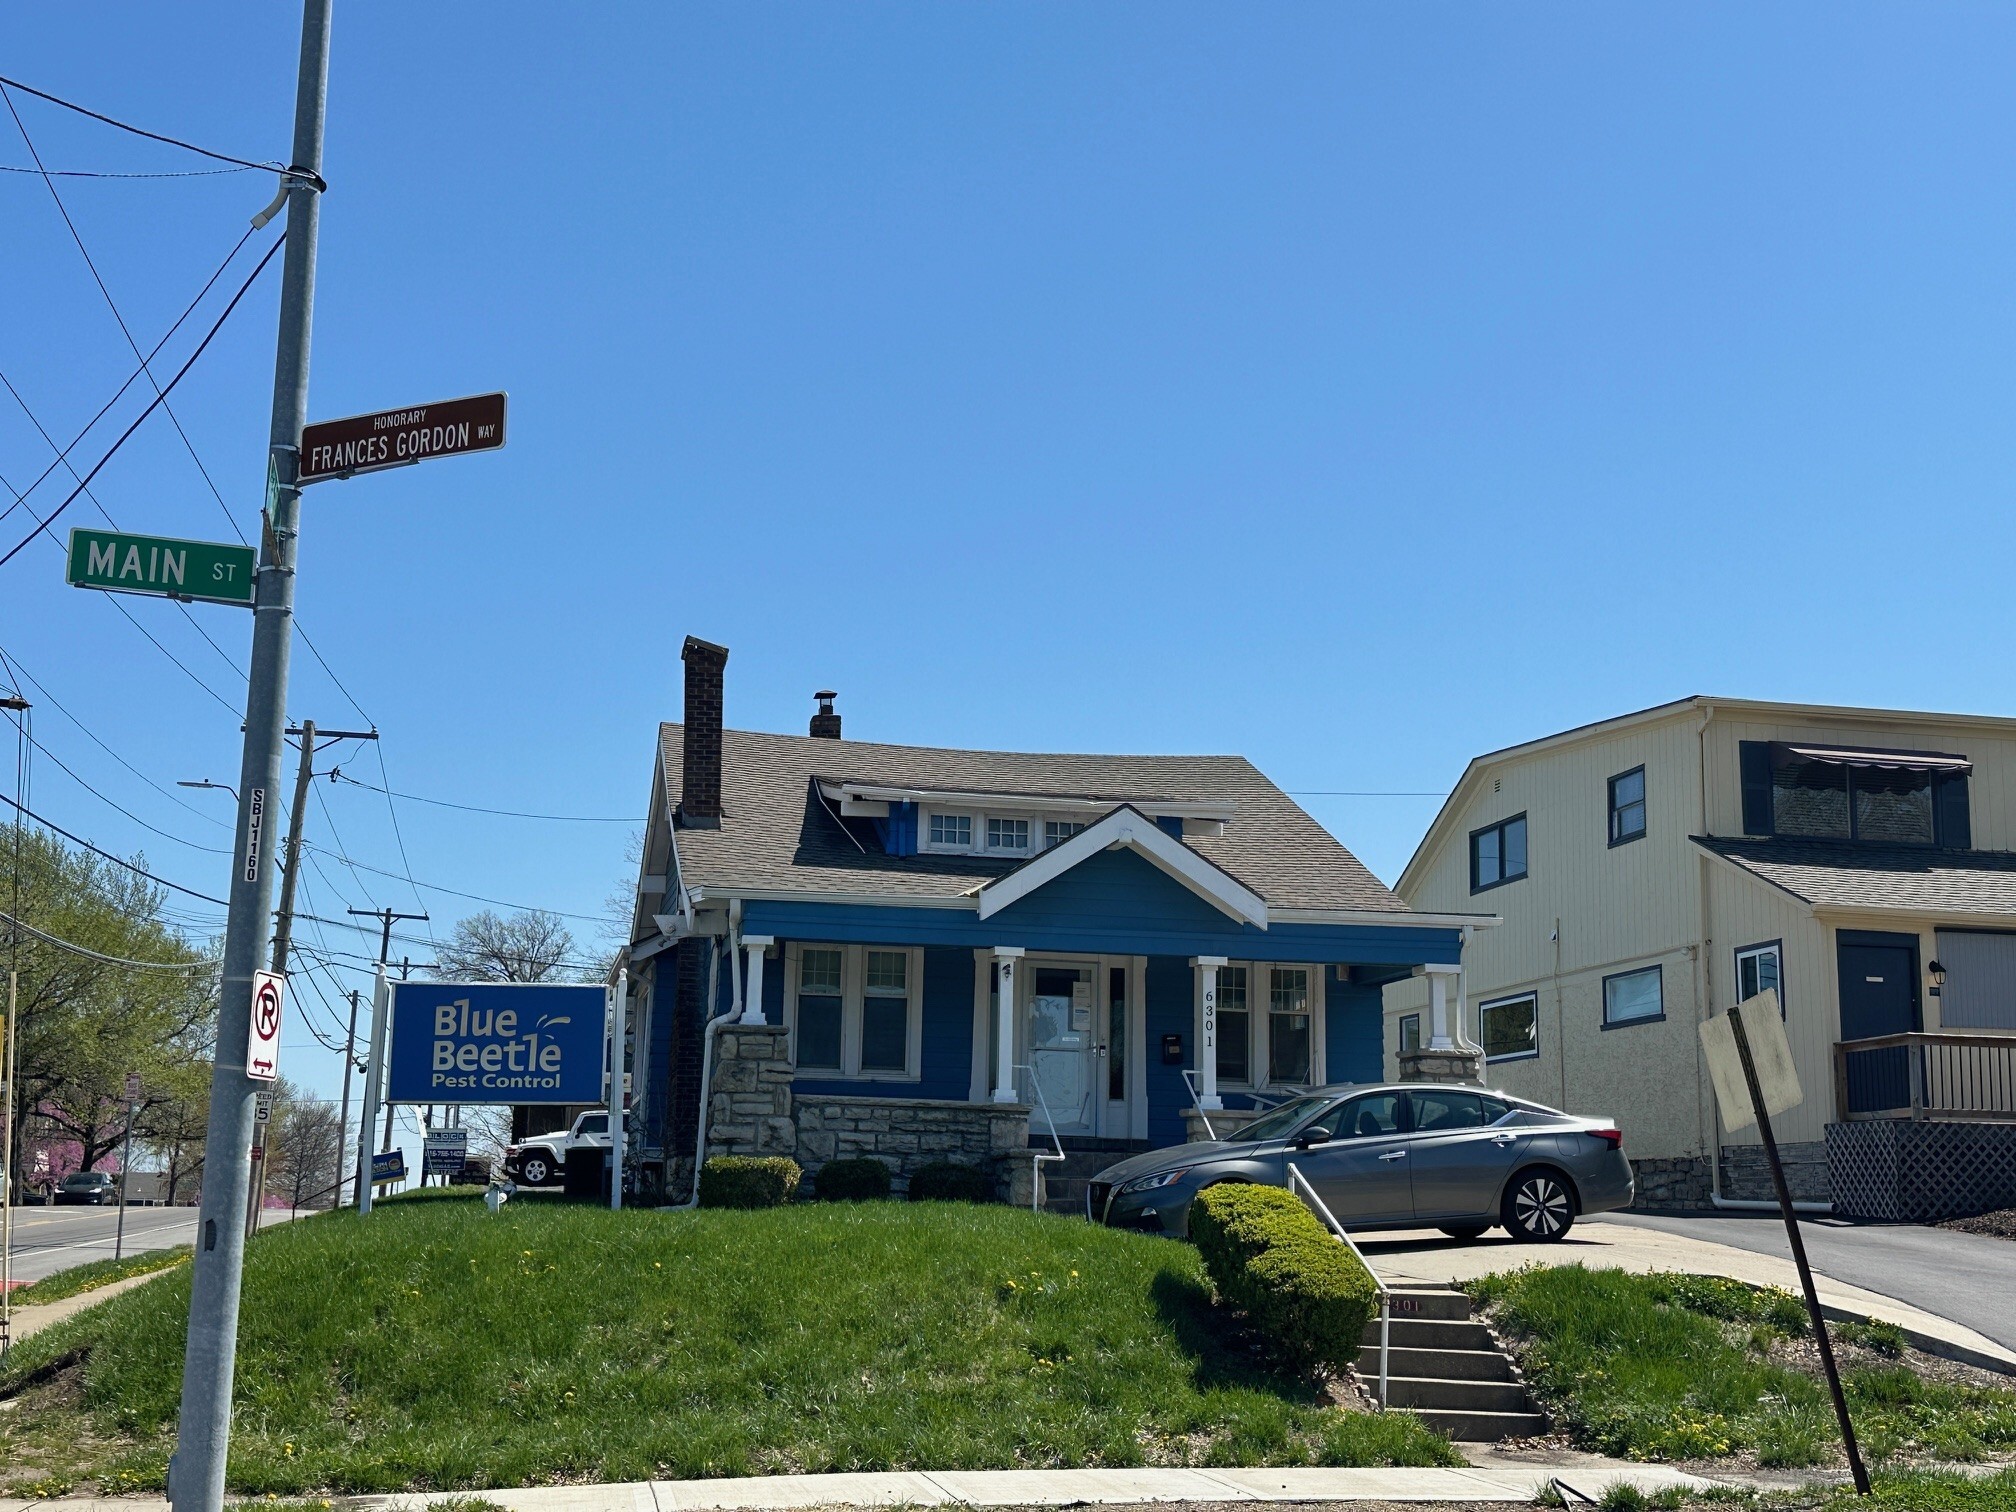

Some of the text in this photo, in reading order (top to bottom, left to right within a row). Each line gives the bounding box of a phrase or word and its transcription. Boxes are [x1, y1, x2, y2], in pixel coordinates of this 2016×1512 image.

[374, 409, 427, 430] HONORARY
[311, 422, 496, 471] FRANCES GORDON WAY
[87, 540, 237, 585] MAIN ST
[247, 789, 263, 881] SBJ1160
[434, 998, 518, 1037] Blue
[1205, 991, 1213, 1047] 6301
[432, 1033, 562, 1072] Beetle
[432, 1073, 560, 1088] Pest Control
